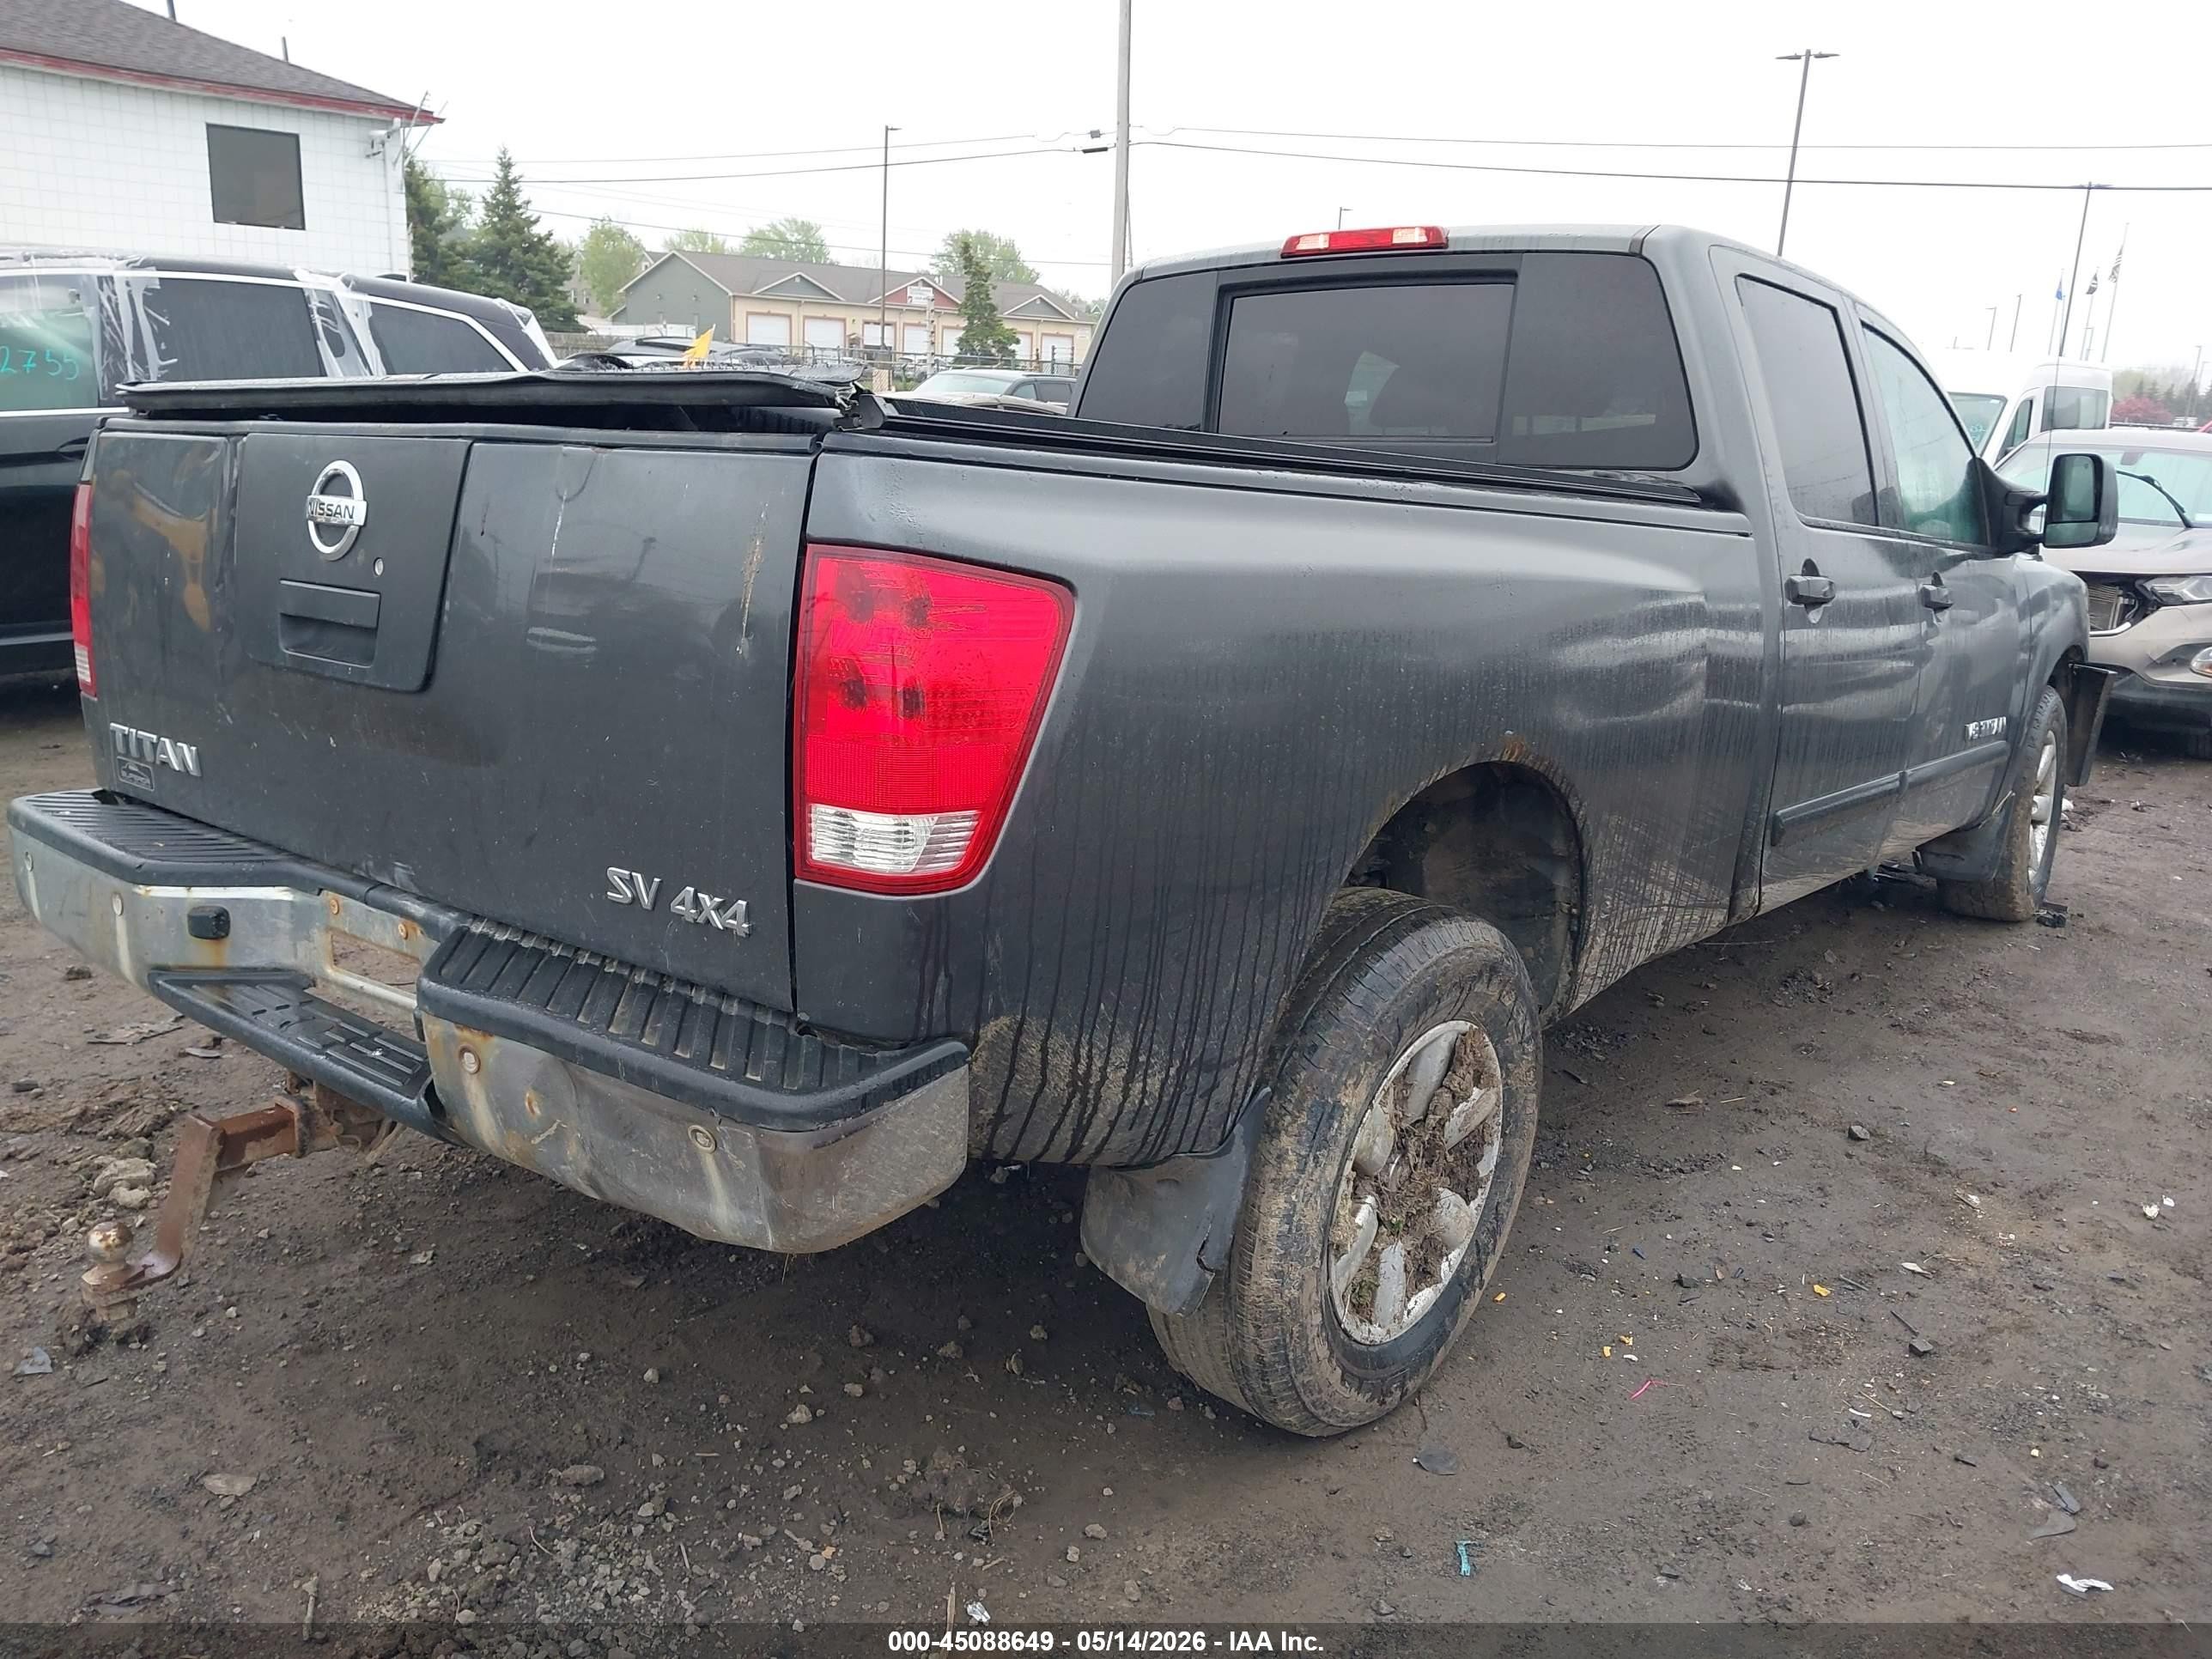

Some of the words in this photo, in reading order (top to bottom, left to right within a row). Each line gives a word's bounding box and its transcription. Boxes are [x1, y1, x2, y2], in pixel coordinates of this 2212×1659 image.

[307, 498, 356, 519] NISSAN
[110, 722, 202, 777] TITAN
[606, 866, 662, 911] SV
